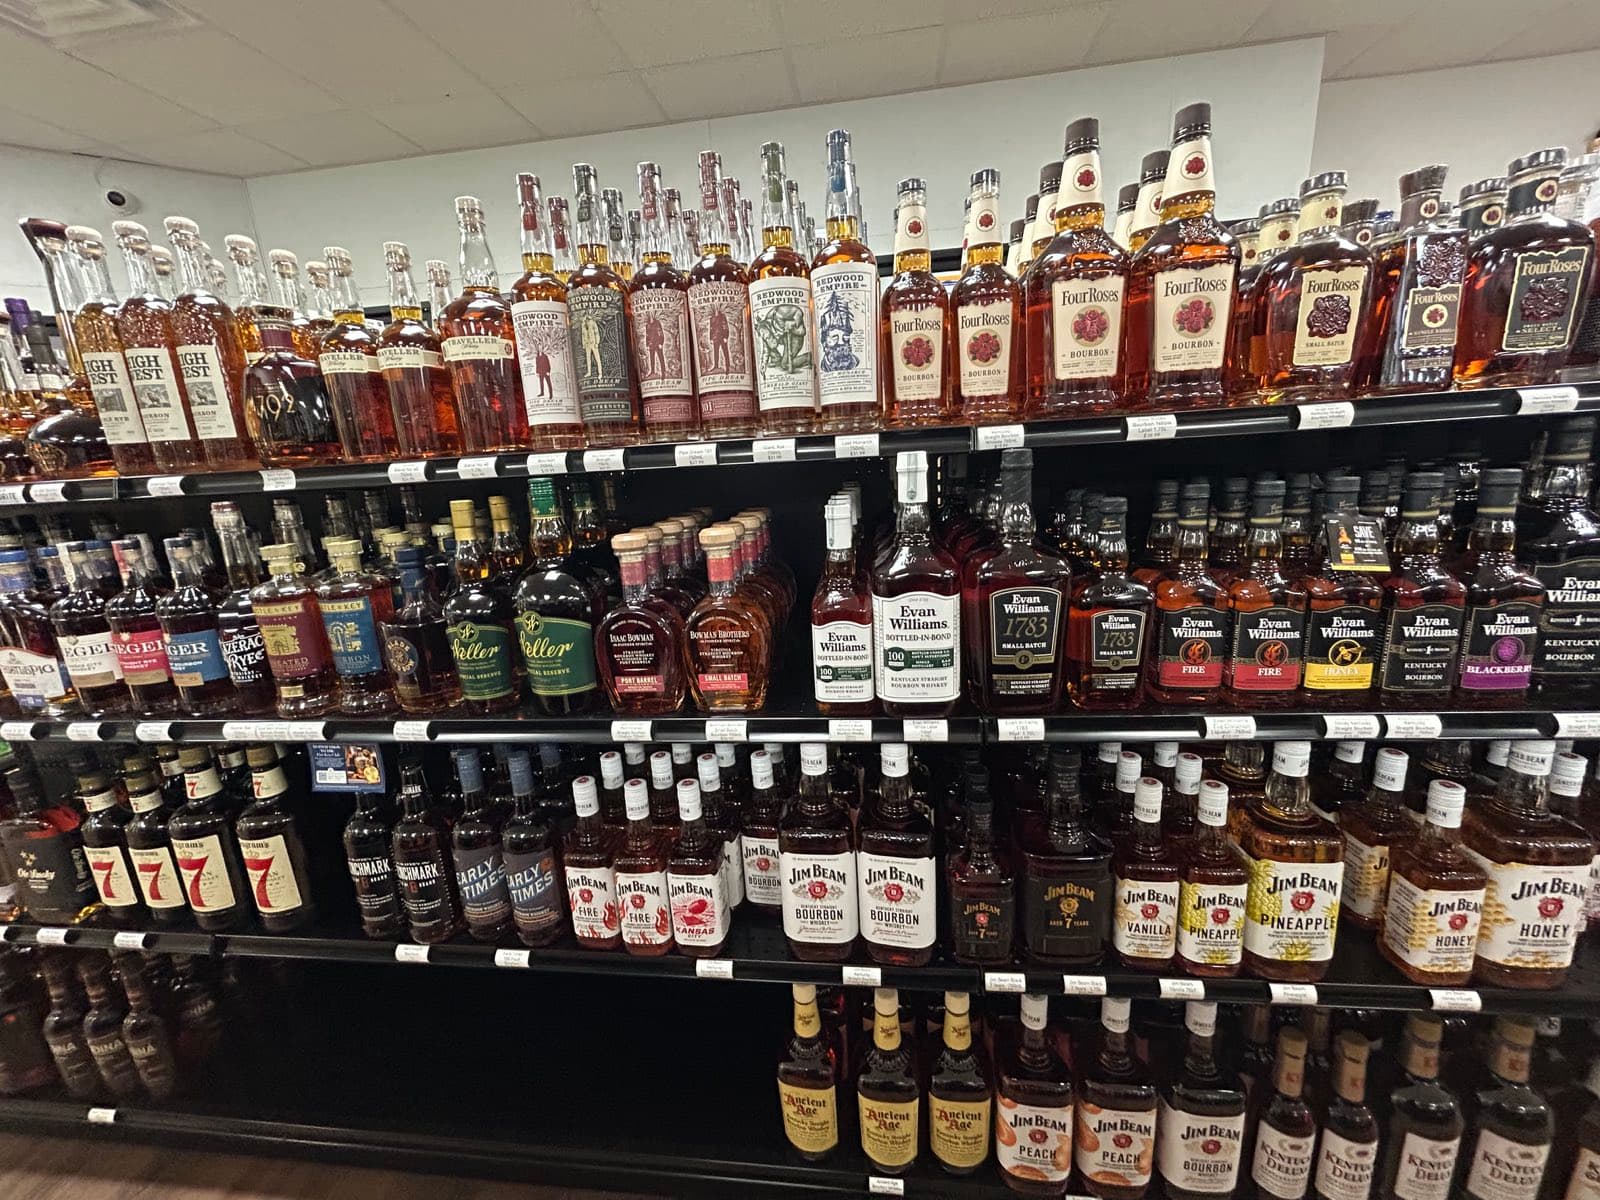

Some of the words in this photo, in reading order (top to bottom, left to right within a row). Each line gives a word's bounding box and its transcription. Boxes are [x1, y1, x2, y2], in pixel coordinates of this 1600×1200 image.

[1521, 261, 1550, 276] Four
[1549, 258, 1582, 273] Roses
[816, 274, 864, 288] REDWOOD
[1164, 281, 1193, 297] Four
[1192, 277, 1227, 292] Roses
[1307, 280, 1332, 294] Four
[1331, 278, 1360, 292] Roses
[820, 283, 859, 293] EMPIRE
[756, 290, 804, 300] REDWOOD
[1061, 291, 1089, 306] Four
[1088, 287, 1119, 303] Roses
[761, 297, 800, 306] EMPIRE
[514, 313, 558, 323] REDWOOD
[517, 320, 554, 328] EMPIRE
[961, 315, 982, 329] Four
[981, 312, 1010, 326] Roses
[894, 319, 916, 334] Four
[915, 317, 941, 331] Roses
[447, 338, 498, 346] TRAVELLER
[1172, 340, 1214, 351] BOURBON
[1070, 349, 1109, 359] BOURBON
[903, 374, 934, 382] BOURBON
[968, 370, 1001, 378] BOURBON
[1353, 526, 1375, 538] SAVE
[1012, 594, 1040, 604] Evan
[900, 605, 937, 617] Evan
[1003, 604, 1050, 614] Williams
[890, 618, 948, 630] Williams
[1108, 615, 1129, 623] Evan
[1182, 617, 1214, 628] Evan
[1258, 618, 1292, 629] Evan
[1332, 617, 1365, 627] Evan
[1414, 615, 1449, 626] Evan
[1495, 613, 1530, 624] Evan
[1003, 616, 1048, 638] 1783
[1101, 622, 1136, 630] Williams
[1403, 626, 1459, 638] Williams
[1483, 624, 1537, 636] Williams
[610, 633, 627, 643] ISAAC
[627, 633, 654, 642] BOWMAN
[690, 631, 717, 640] BOWMAN
[718, 630, 750, 639] BROTHERS
[828, 632, 857, 642] Evan
[1171, 627, 1223, 638] Williams
[1248, 628, 1300, 639] Williams
[1320, 627, 1374, 638] Williams
[1101, 631, 1135, 648] 1783
[1544, 639, 1600, 647] KENTUCKY
[820, 642, 867, 652] Williams
[887, 651, 904, 661] 100
[820, 668, 832, 676] 100
[1182, 665, 1206, 674] FIRE
[1258, 667, 1282, 676] FIRE
[705, 674, 722, 682] SMALL
[187, 782, 197, 797] 7
[253, 781, 262, 798] 7
[744, 846, 759, 859] JIM
[92, 860, 117, 899] 7
[138, 862, 165, 900] 7
[178, 855, 209, 907] 7
[789, 867, 811, 885] JIM
[812, 864, 847, 886] BEAM
[865, 869, 888, 885] JIM
[889, 866, 925, 890] BEAM
[245, 855, 274, 908] 7
[462, 863, 506, 900] TIMES
[511, 871, 554, 903] TIMES
[567, 877, 580, 890] JIM
[579, 876, 607, 892] BEAM
[749, 878, 781, 887] BOURBON
[1267, 876, 1298, 895] JIM
[616, 882, 633, 896] JIM
[632, 880, 660, 896] BEAM
[670, 884, 686, 898] JIM
[686, 882, 713, 898] BEAM
[1044, 886, 1065, 901] JIM
[1065, 883, 1096, 901] BEAM
[1512, 881, 1547, 900] JIM
[1124, 891, 1146, 905] JIM
[1193, 896, 1217, 910] JIM
[578, 906, 599, 917] FIRE
[796, 908, 843, 920] BOURBON
[964, 904, 979, 915] JIM
[979, 902, 1000, 916] BEAM
[1429, 902, 1457, 916] JIM
[629, 912, 651, 923] FIRE
[870, 910, 919, 925] BOURBON
[1065, 918, 1071, 929] 7
[1260, 914, 1335, 930] PINEAPPLE
[676, 926, 715, 936] KANSAS
[979, 928, 986, 939] 7
[1127, 922, 1171, 935] VANILLA
[1520, 924, 1570, 938] HONEY
[1436, 936, 1473, 947] HONEY
[783, 1094, 826, 1107] Ancient
[793, 1105, 817, 1116] Age
[865, 1107, 910, 1121] Ancient
[935, 1106, 982, 1121] Ancient
[876, 1118, 900, 1130] Age
[948, 1117, 971, 1130] Age
[1010, 1116, 1035, 1128] JIM
[1035, 1115, 1066, 1133] BEAM
[1093, 1121, 1120, 1133] JIM
[1120, 1119, 1152, 1136] BEAM
[1181, 1126, 1208, 1140] JIM
[1208, 1124, 1240, 1140] BEAM
[1019, 1145, 1057, 1159] PEACH
[1102, 1151, 1140, 1164] PEACH
[1183, 1162, 1232, 1173] BOURBON
